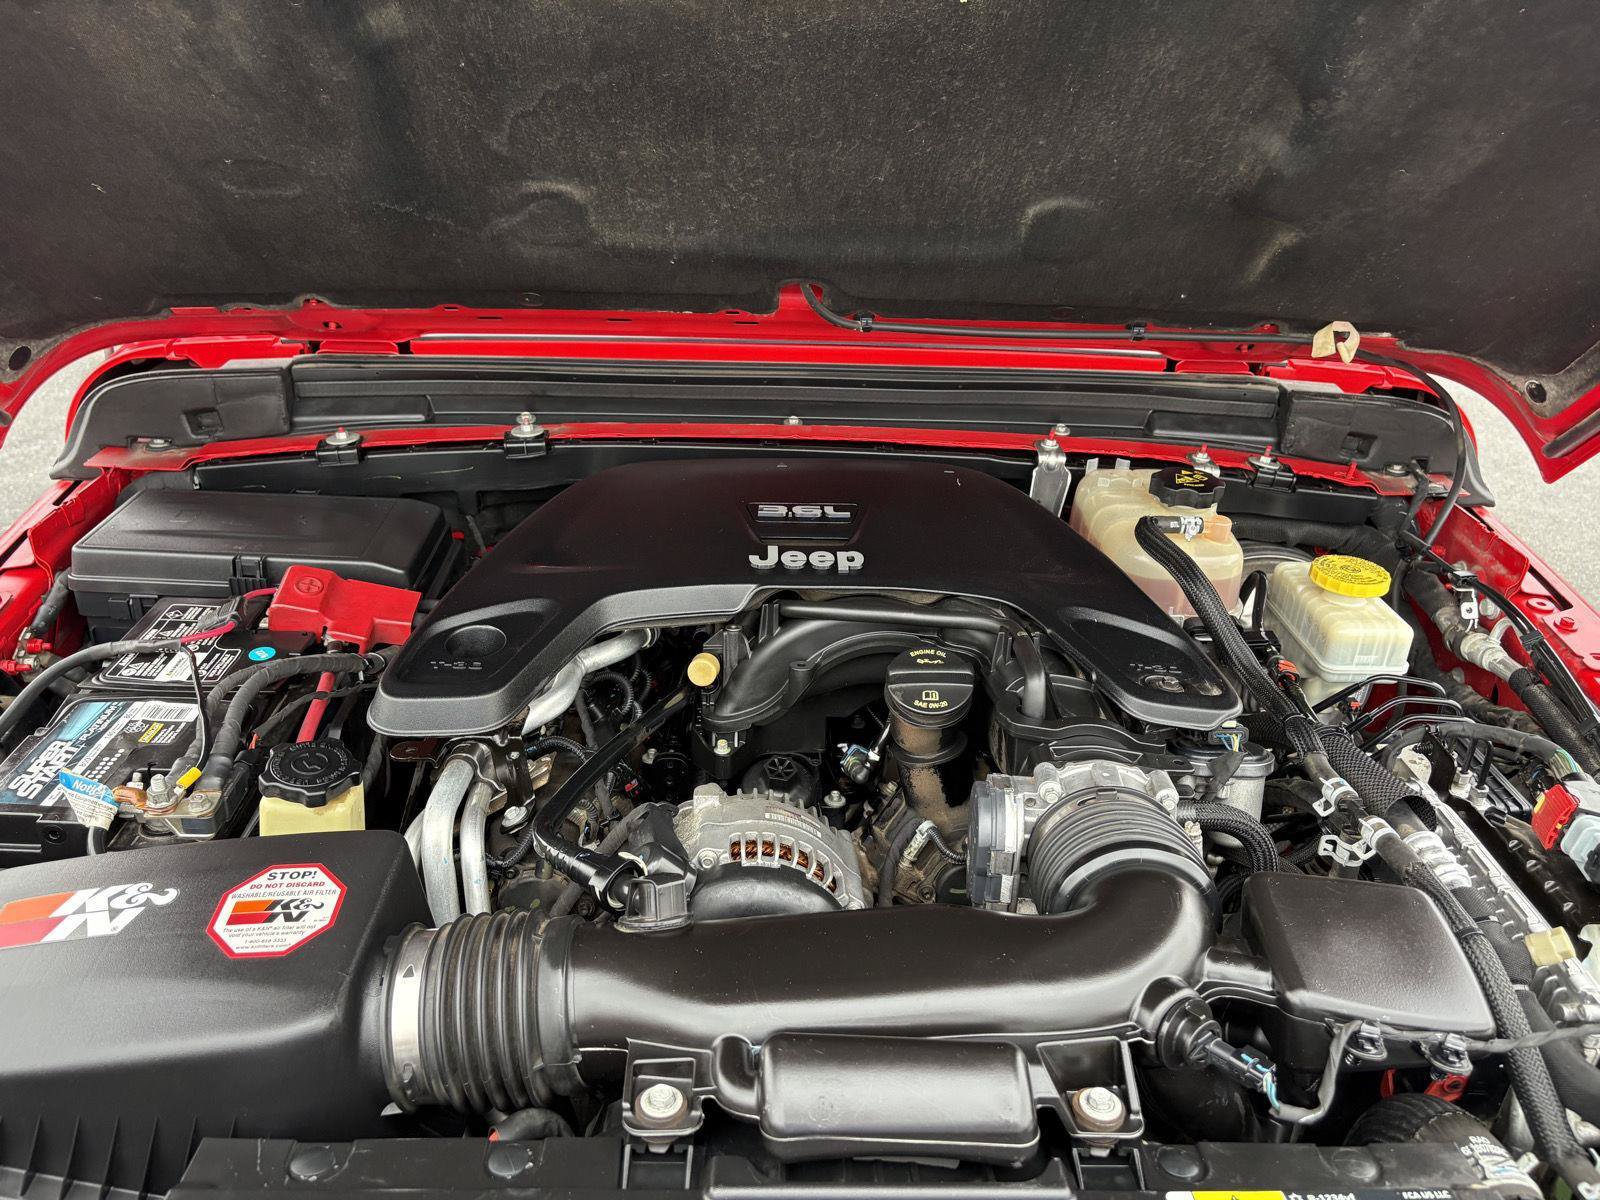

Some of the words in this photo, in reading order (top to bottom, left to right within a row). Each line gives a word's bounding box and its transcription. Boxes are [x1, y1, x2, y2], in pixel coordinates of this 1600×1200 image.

[757, 505, 851, 518] 3.6L
[748, 545, 865, 573] Jeep
[910, 649, 935, 657] ENGINE
[914, 700, 928, 708] SAE
[8, 740, 67, 790] SUPER
[16, 741, 79, 800] START
[267, 870, 318, 881] STOP!
[315, 888, 337, 896] FILTER
